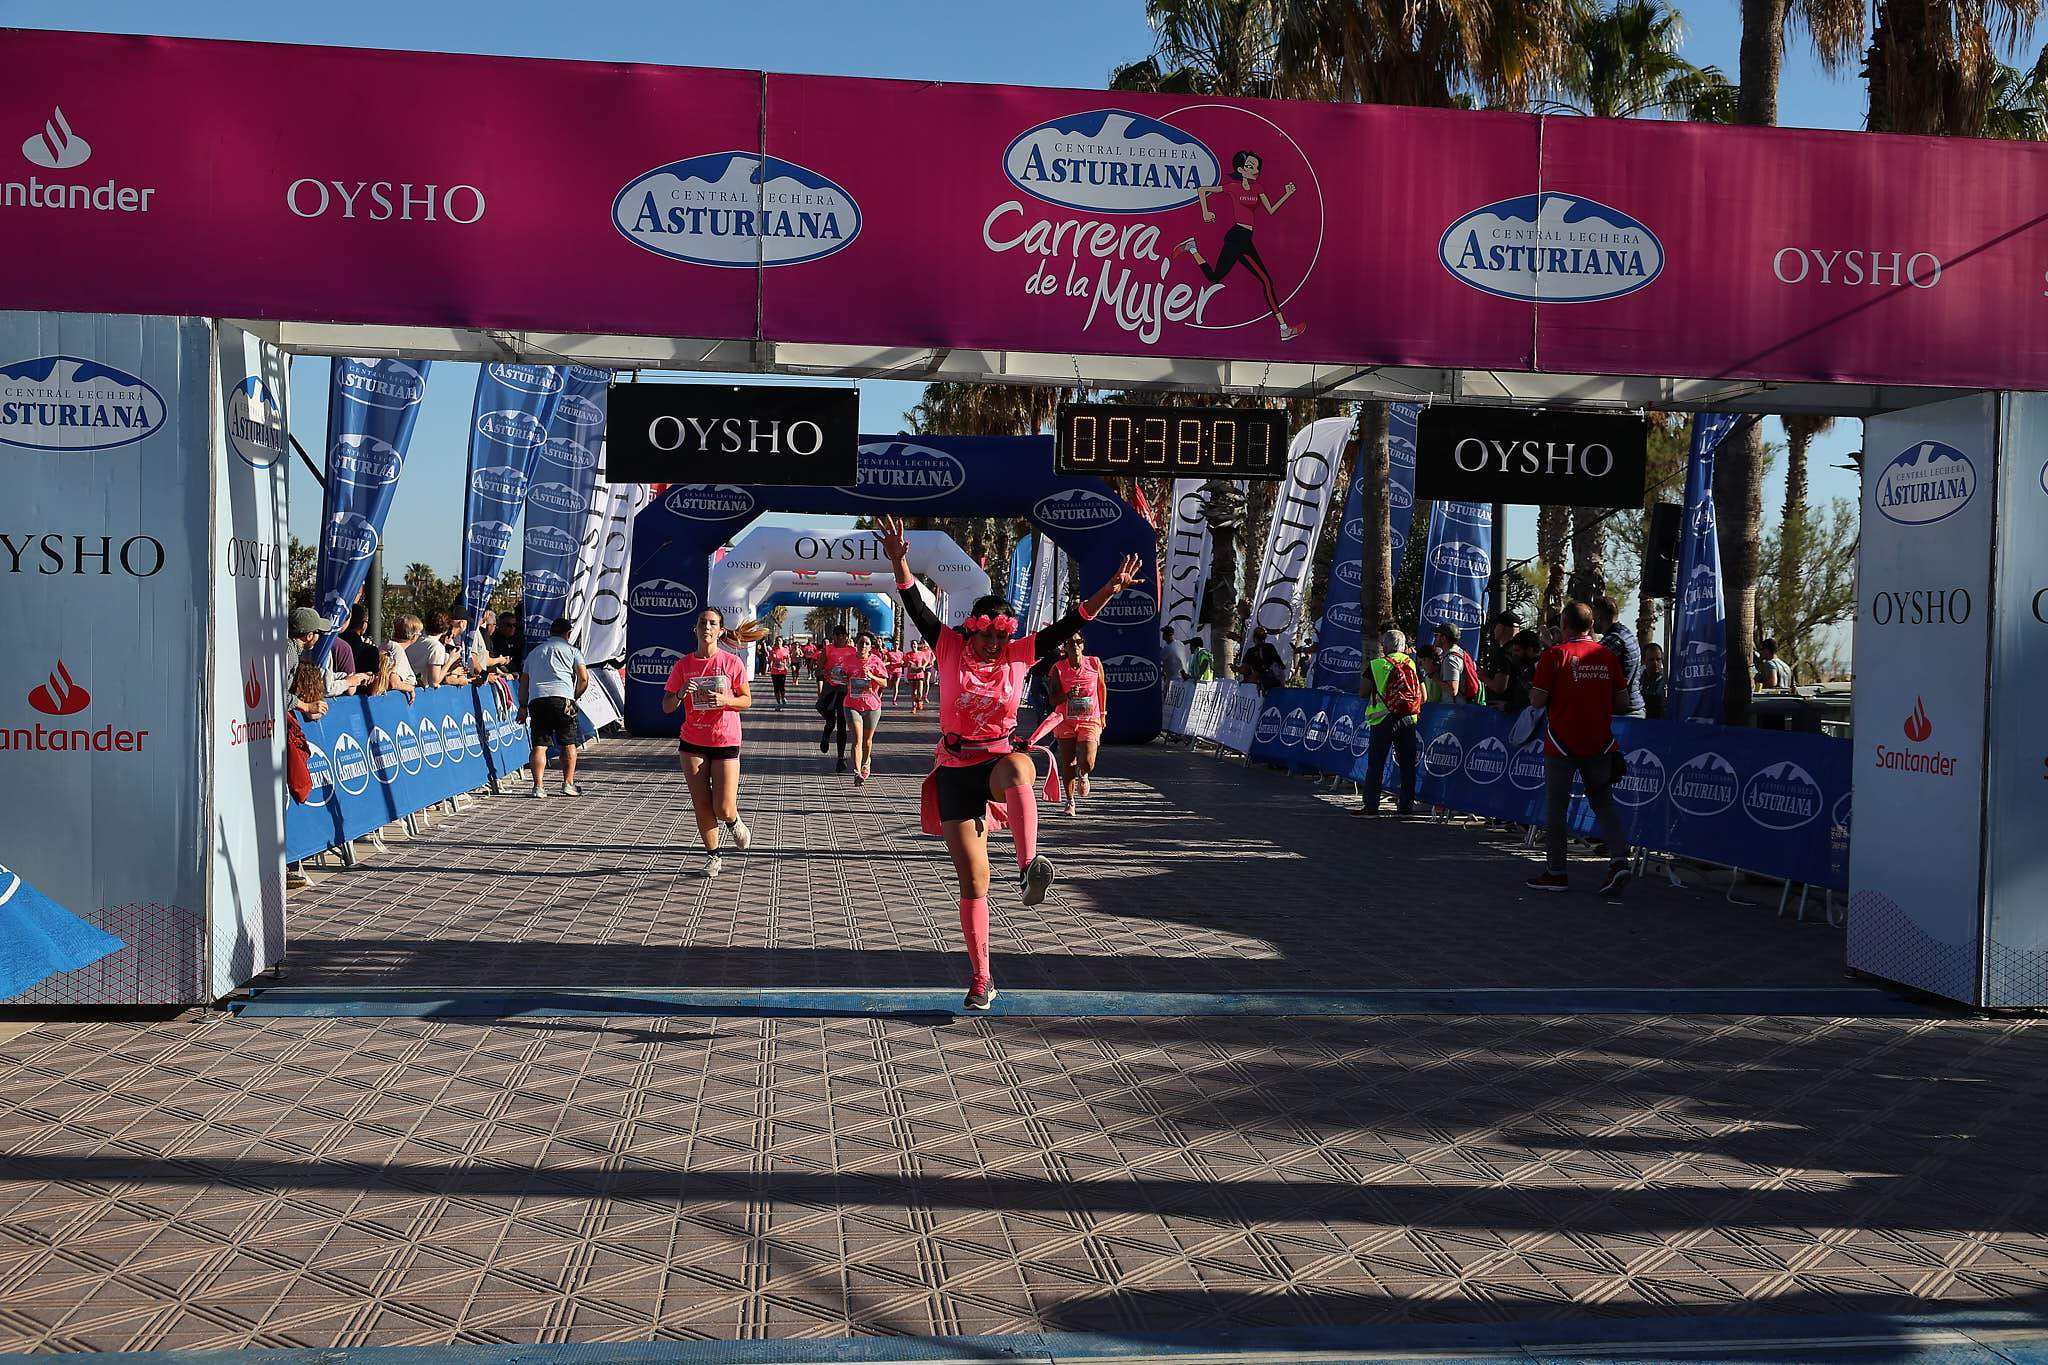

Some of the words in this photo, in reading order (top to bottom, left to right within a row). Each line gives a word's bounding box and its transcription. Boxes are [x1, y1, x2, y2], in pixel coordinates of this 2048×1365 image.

[1054, 142, 1123, 156] CENTRAL
[1129, 146, 1198, 160] LECHERA
[1020, 143, 1201, 190] ASTURIANA
[0, 176, 156, 212] ntander
[286, 178, 486, 225] OYSHO
[671, 189, 748, 202] CENTRAL
[631, 190, 843, 240] ASTURIANA
[982, 200, 1161, 262] Carrera
[1492, 228, 1562, 241] CENTRAL
[1569, 231, 1640, 245] LECHERA
[1456, 228, 1648, 277] ASTURIANA
[1773, 246, 1942, 290] OYSHO
[1025, 261, 1059, 297] de
[1067, 259, 1088, 298] la
[1082, 255, 1227, 345] Mujer
[5, 387, 73, 398] CENTRAL
[77, 390, 144, 401] LECHERA
[0, 401, 151, 428] STURIANA
[231, 401, 282, 451] ASTURIANA
[557, 405, 599, 423] STURIANA
[648, 415, 824, 456] OYSHO
[1072, 416, 1271, 466] 00:38:01
[1453, 437, 1614, 477] OYSHO
[857, 467, 955, 487] STURIANA
[1896, 470, 1928, 481] CENTRAL
[1930, 464, 1965, 477] LECHERA
[531, 488, 581, 510] ASTURIANA
[670, 493, 747, 511] ASTURIANA
[1881, 476, 1968, 507] ASTURIANA
[1041, 506, 1116, 519] ASTURIANA
[1441, 501, 1492, 521] ASTURIAN
[0, 534, 166, 578] YSHO
[1256, 450, 1330, 636] OYSHO
[227, 536, 282, 580] OYSHO
[727, 560, 761, 569] OYSHO
[938, 563, 972, 572] OYSHO
[632, 591, 693, 609] ASTURIANA
[715, 606, 743, 614] YSHO
[954, 610, 972, 618] OYS
[1100, 605, 1153, 617] STURIANA
[1873, 588, 1972, 626] OYSHO
[1427, 605, 1482, 625] ASTURIANA
[630, 660, 673, 675] ASTURIA
[1105, 671, 1156, 682] STURIANA
[0, 723, 149, 752] antander
[230, 717, 276, 747] Santander
[1511, 757, 1545, 779] ASTURIAN
[1876, 744, 1957, 777] Santander
[1673, 773, 1731, 803] ASTURIANA
[1747, 782, 1812, 817] ASTURIANA
